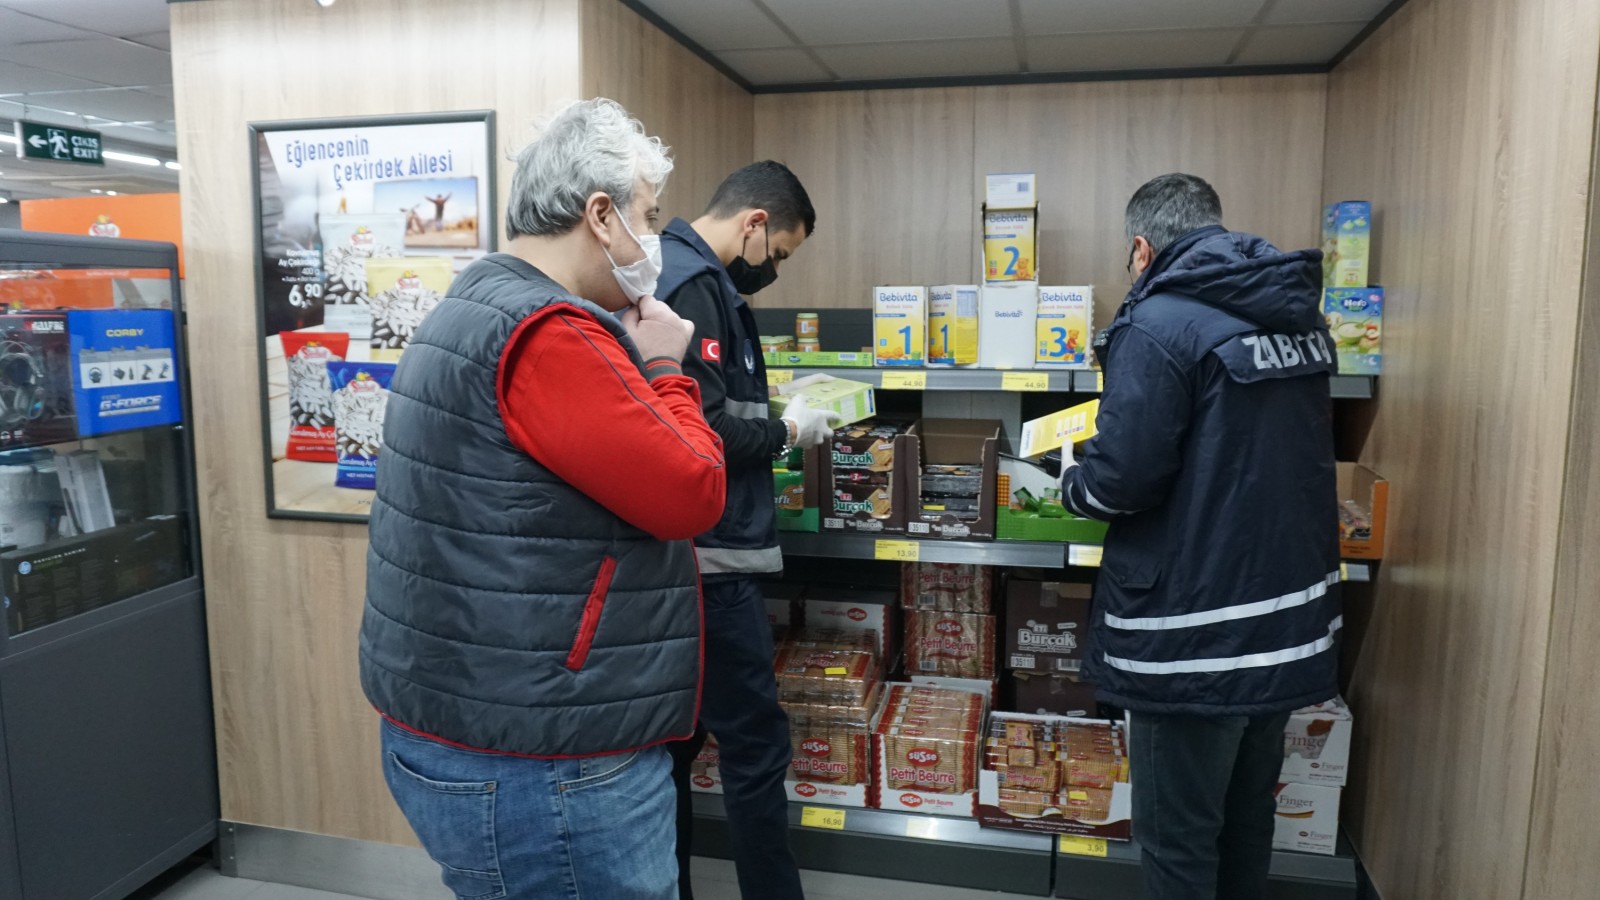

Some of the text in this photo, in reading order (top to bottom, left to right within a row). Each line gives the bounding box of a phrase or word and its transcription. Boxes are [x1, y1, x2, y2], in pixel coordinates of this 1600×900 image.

[73, 148, 98, 159] EXIT
[286, 135, 369, 168] Eğlencenin
[333, 150, 453, 190] Çekirdek Ailesi
[1003, 246, 1020, 276] 2
[880, 293, 918, 301] Bebivita
[1042, 293, 1083, 302] Bebivita
[106, 328, 144, 338] CORBY
[899, 325, 911, 355] 1
[940, 324, 948, 354] 1
[1049, 327, 1067, 357] 3
[100, 395, 163, 411] G-FORCE
[831, 451, 874, 466] Burçak
[853, 473, 859, 481] 3
[833, 499, 873, 514] Burçak
[897, 550, 917, 558] 13,90
[920, 572, 975, 584] Petit Beurre
[921, 638, 977, 652] Petit Beurre
[1019, 630, 1076, 649] Burçak
[791, 758, 849, 774] etit Beurre
[1321, 763, 1344, 772] Finger
[891, 768, 956, 784] Petit Beurre
[1279, 794, 1314, 808] Finger
[822, 817, 842, 826] 16,90
